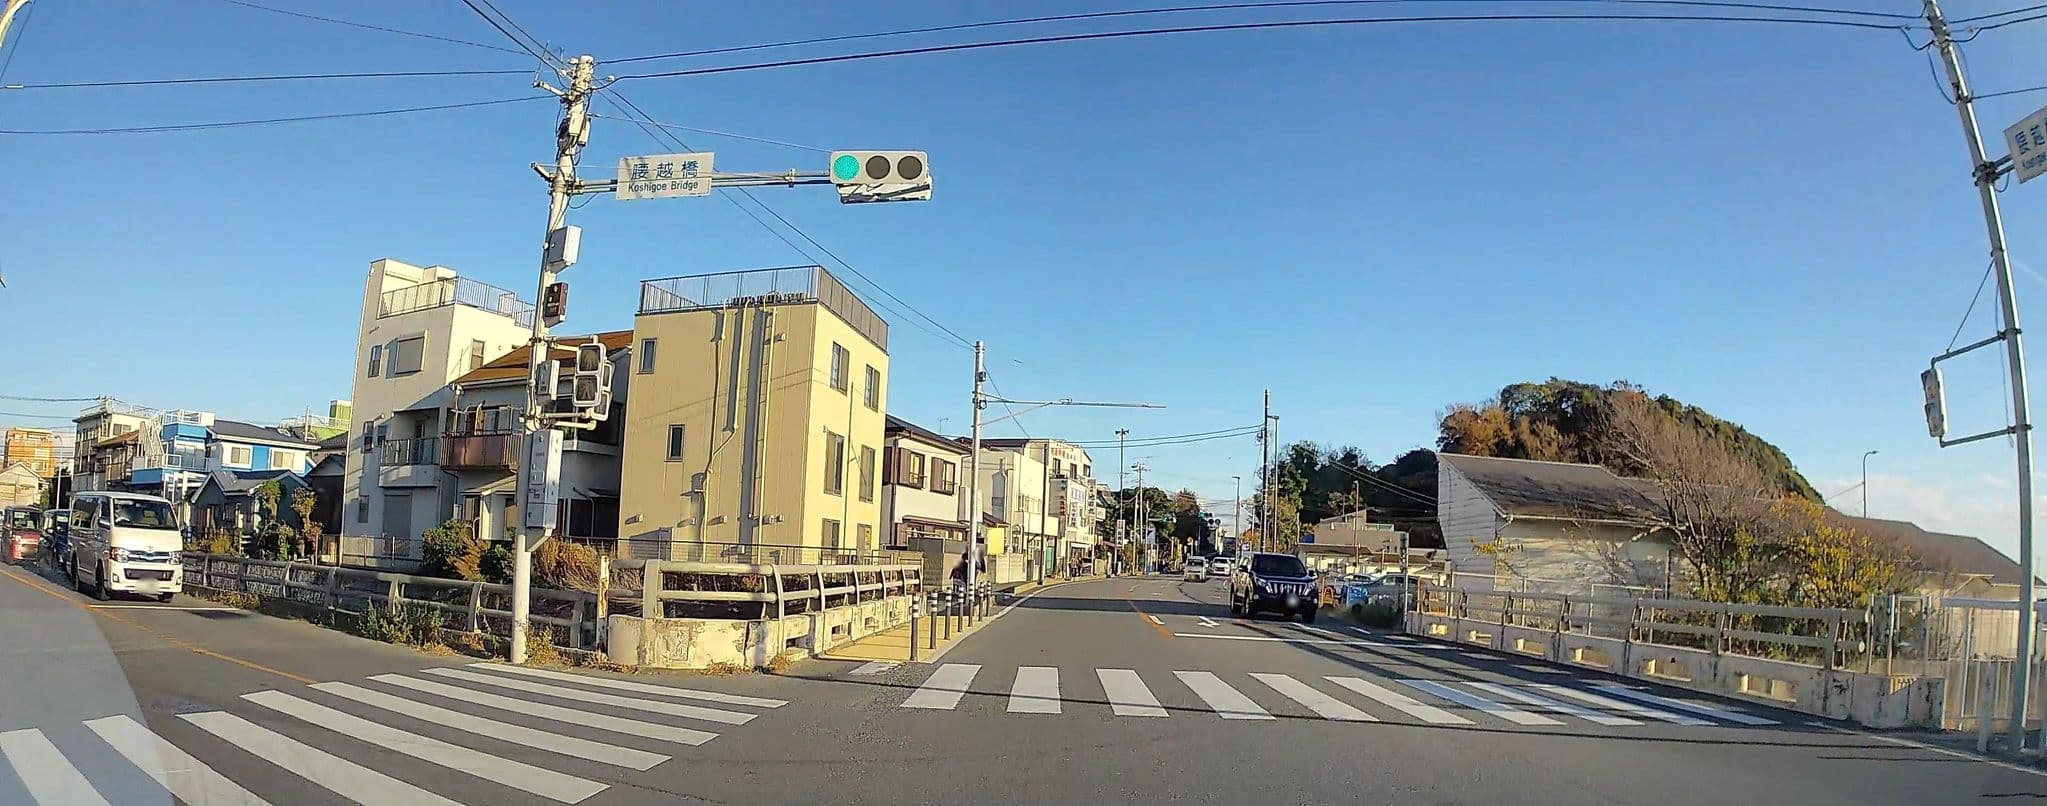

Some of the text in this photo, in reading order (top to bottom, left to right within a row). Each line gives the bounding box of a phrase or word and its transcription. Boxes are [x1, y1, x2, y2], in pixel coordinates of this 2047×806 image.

[631, 160, 699, 180] 腰越橋
[628, 180, 699, 193] Koshigoe Bridge
